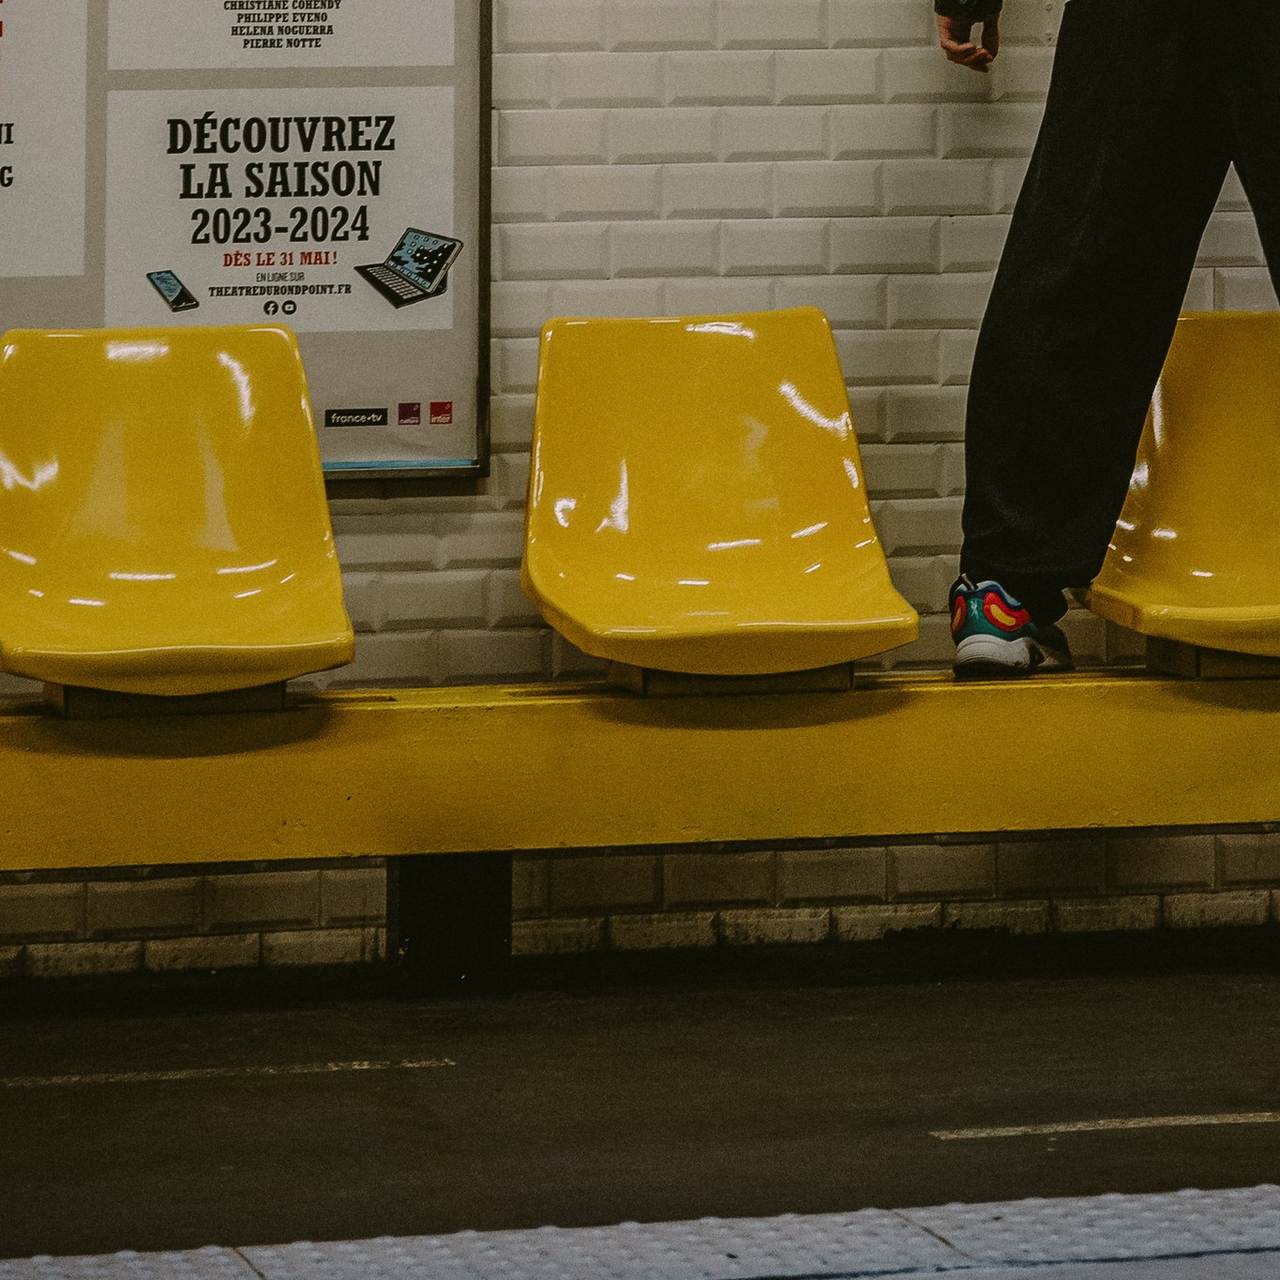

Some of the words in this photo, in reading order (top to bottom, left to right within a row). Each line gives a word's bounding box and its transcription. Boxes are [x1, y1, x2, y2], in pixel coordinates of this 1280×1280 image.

[223, 0, 289, 10] CHRISTIANE
[291, 0, 342, 10] COHENDY
[237, 12, 289, 23] PHILIPPE
[292, 12, 328, 23] EVENO
[230, 25, 274, 36] HELENA
[277, 25, 334, 36] NOGUERRA
[242, 38, 283, 49] PIERRE
[286, 38, 322, 49] NOTTE
[166, 110, 396, 154] DÉCOUVREZ
[179, 162, 233, 199] LA
[244, 160, 383, 198] SAISON
[190, 204, 370, 244] 2023-2024
[222, 250, 251, 268] DÈS
[255, 251, 276, 267] LE
[279, 251, 294, 267] 31
[256, 272, 267, 283] EN
[208, 283, 352, 298] THEATREDURONDPOINT.FR
